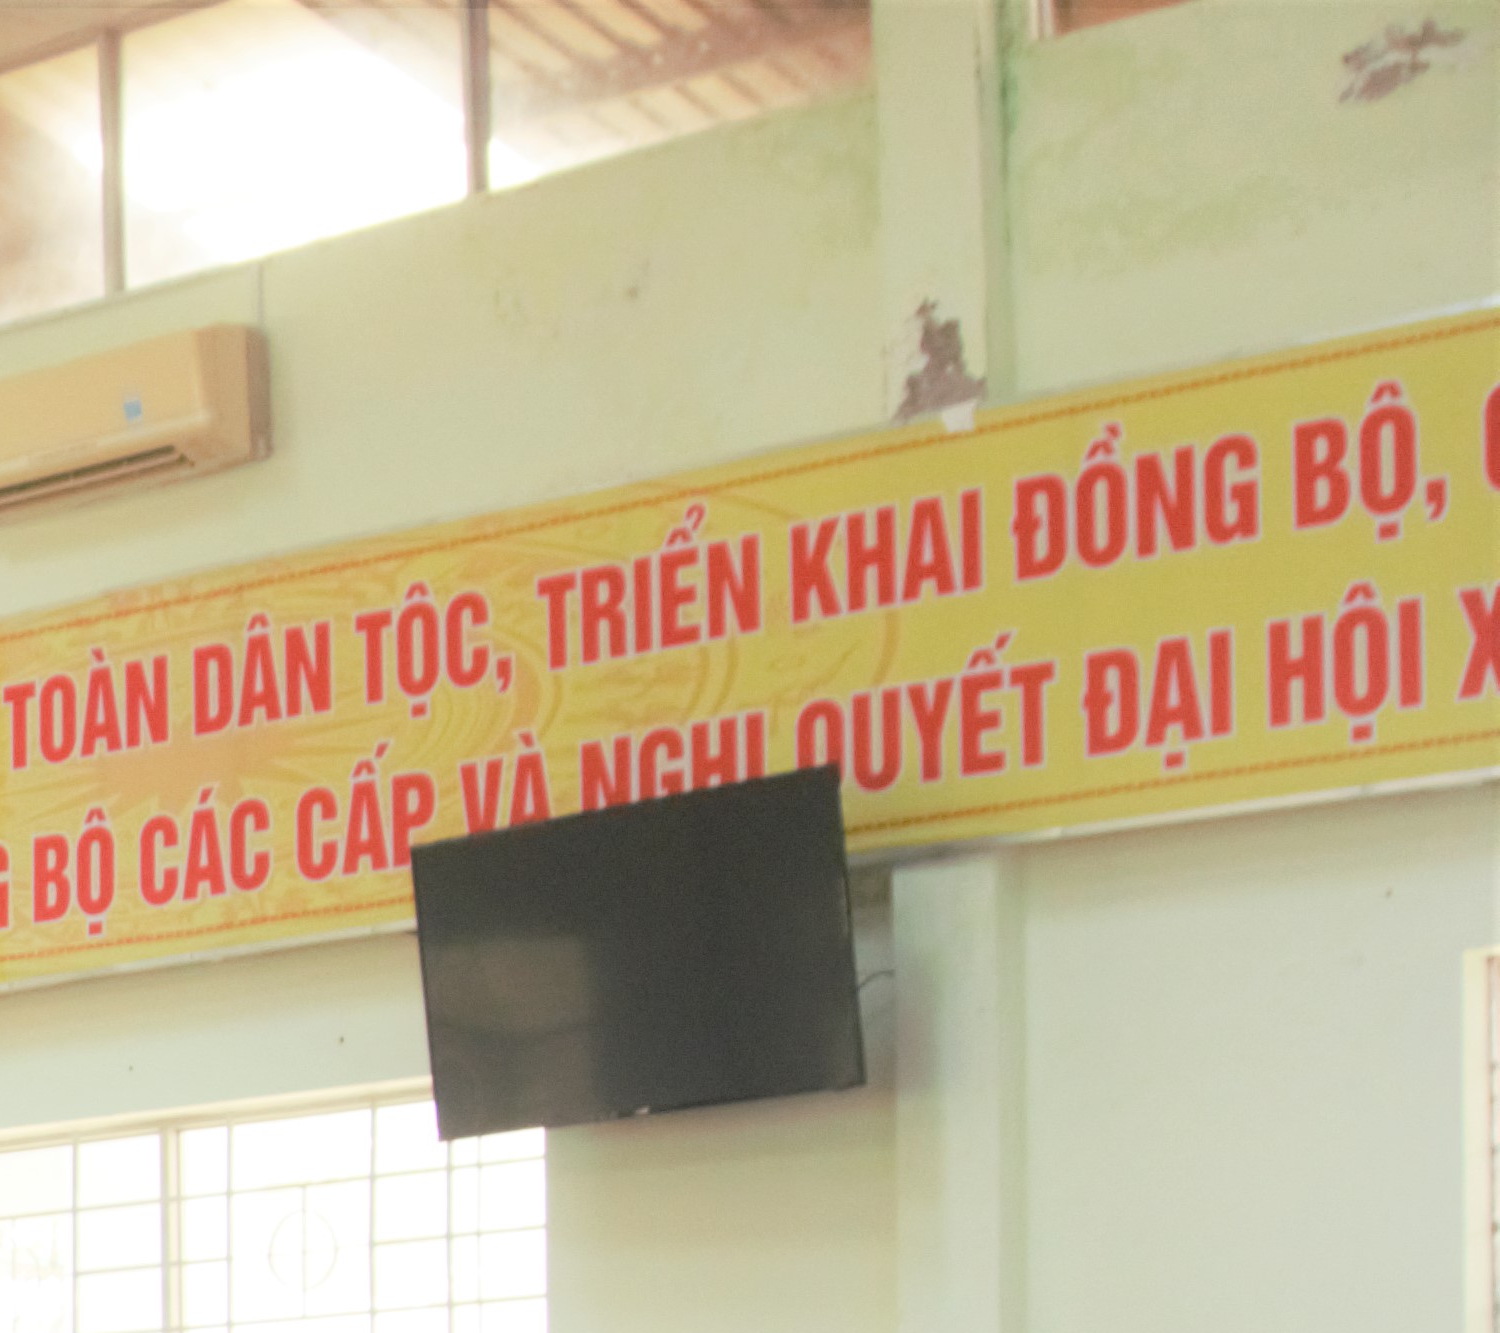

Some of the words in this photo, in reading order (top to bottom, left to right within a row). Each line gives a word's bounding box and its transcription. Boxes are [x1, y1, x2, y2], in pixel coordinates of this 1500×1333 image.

[1, 648, 170, 770] TOÀN
[192, 613, 332, 737] DÂN
[353, 582, 513, 719] TỘC,
[535, 502, 761, 671] TRIỂN
[789, 489, 982, 624] KHAI
[1010, 421, 1259, 581] ĐỒNG
[1293, 378, 1447, 542] BỘ,
[32, 807, 116, 936] BỘ
[138, 787, 271, 907] CÁC
[295, 743, 436, 882] CẤP
[459, 732, 551, 836] VÀ
[795, 632, 1055, 793] QUYẾT
[1081, 631, 1232, 769] ĐẠI
[1267, 583, 1423, 742] HỘI
